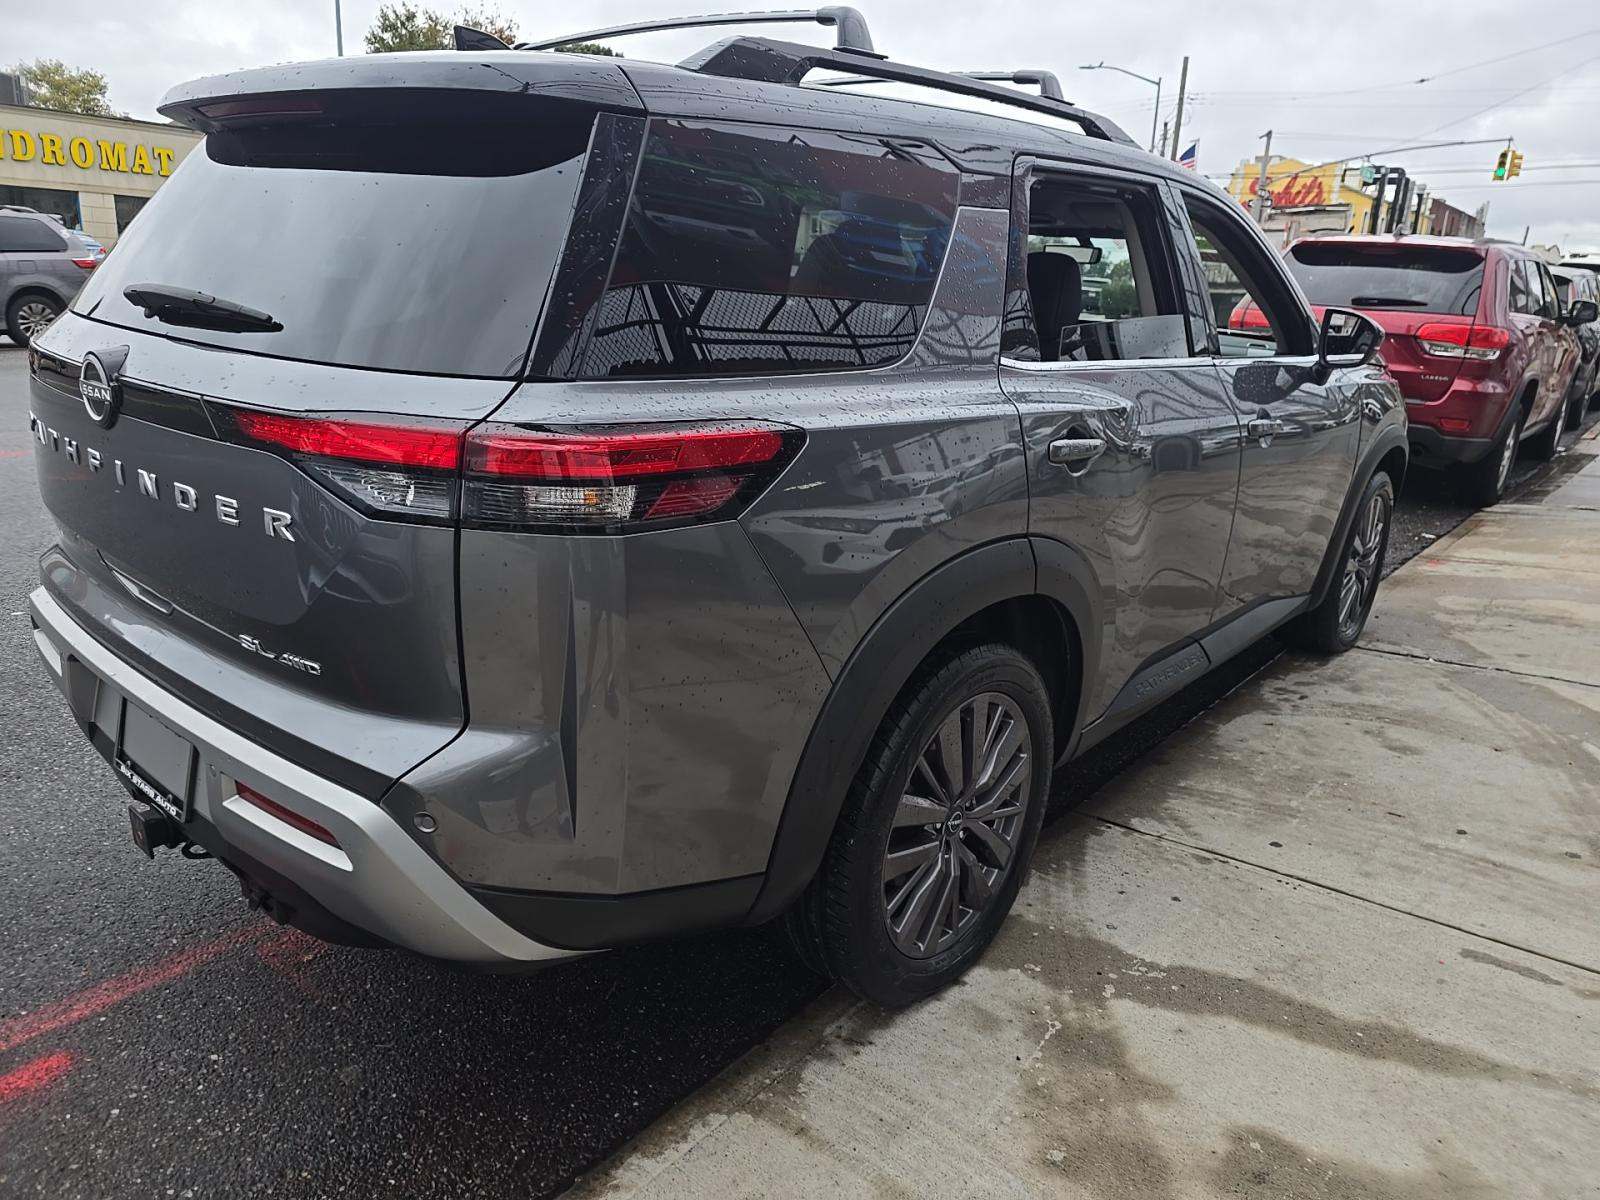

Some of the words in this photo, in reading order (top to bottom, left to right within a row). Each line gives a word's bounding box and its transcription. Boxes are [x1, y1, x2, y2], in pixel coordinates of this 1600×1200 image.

[0, 129, 175, 177] DROMAT
[81, 383, 111, 401] SSAN
[155, 795, 177, 817] AUTO
